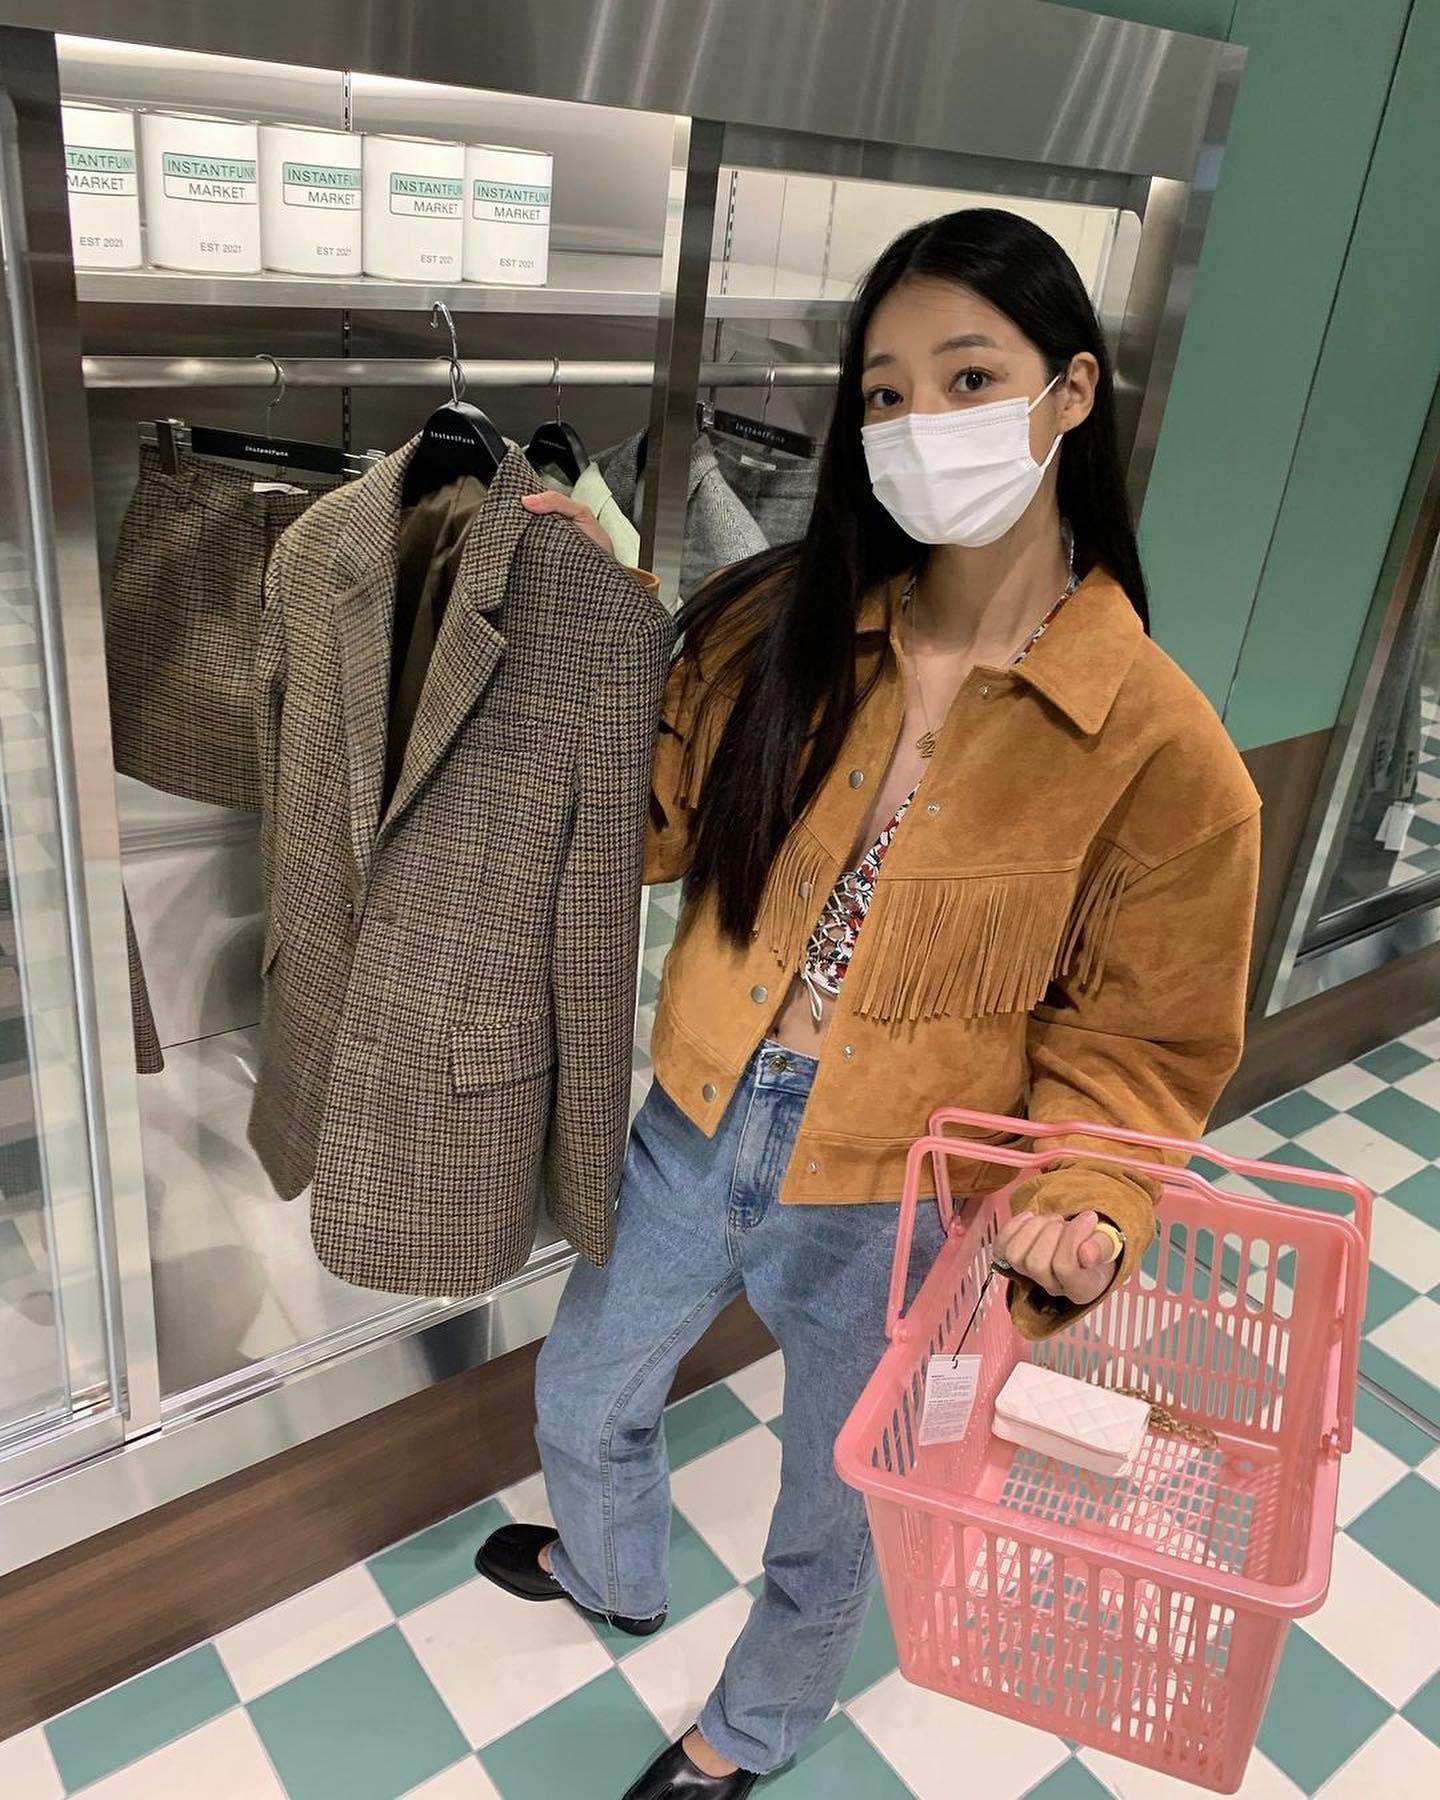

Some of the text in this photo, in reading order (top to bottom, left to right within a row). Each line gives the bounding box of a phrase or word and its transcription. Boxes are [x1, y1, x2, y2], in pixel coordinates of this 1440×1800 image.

[67, 152, 133, 169] TANTFUN
[66, 175, 124, 190] MARKET
[287, 168, 359, 186] INSTANTFU
[188, 183, 246, 199] MARKET
[394, 178, 463, 196] INSTANTFU
[308, 191, 356, 205] MARKET
[476, 186, 550, 203] INSTANTFUN
[414, 200, 458, 214] MARKET
[494, 206, 541, 221] MARKET
[79, 237, 124, 248] EST 2021
[199, 242, 242, 254] EST 2021
[316, 246, 335, 256] EST
[420, 254, 438, 264] EST
[499, 258, 516, 268] EST
